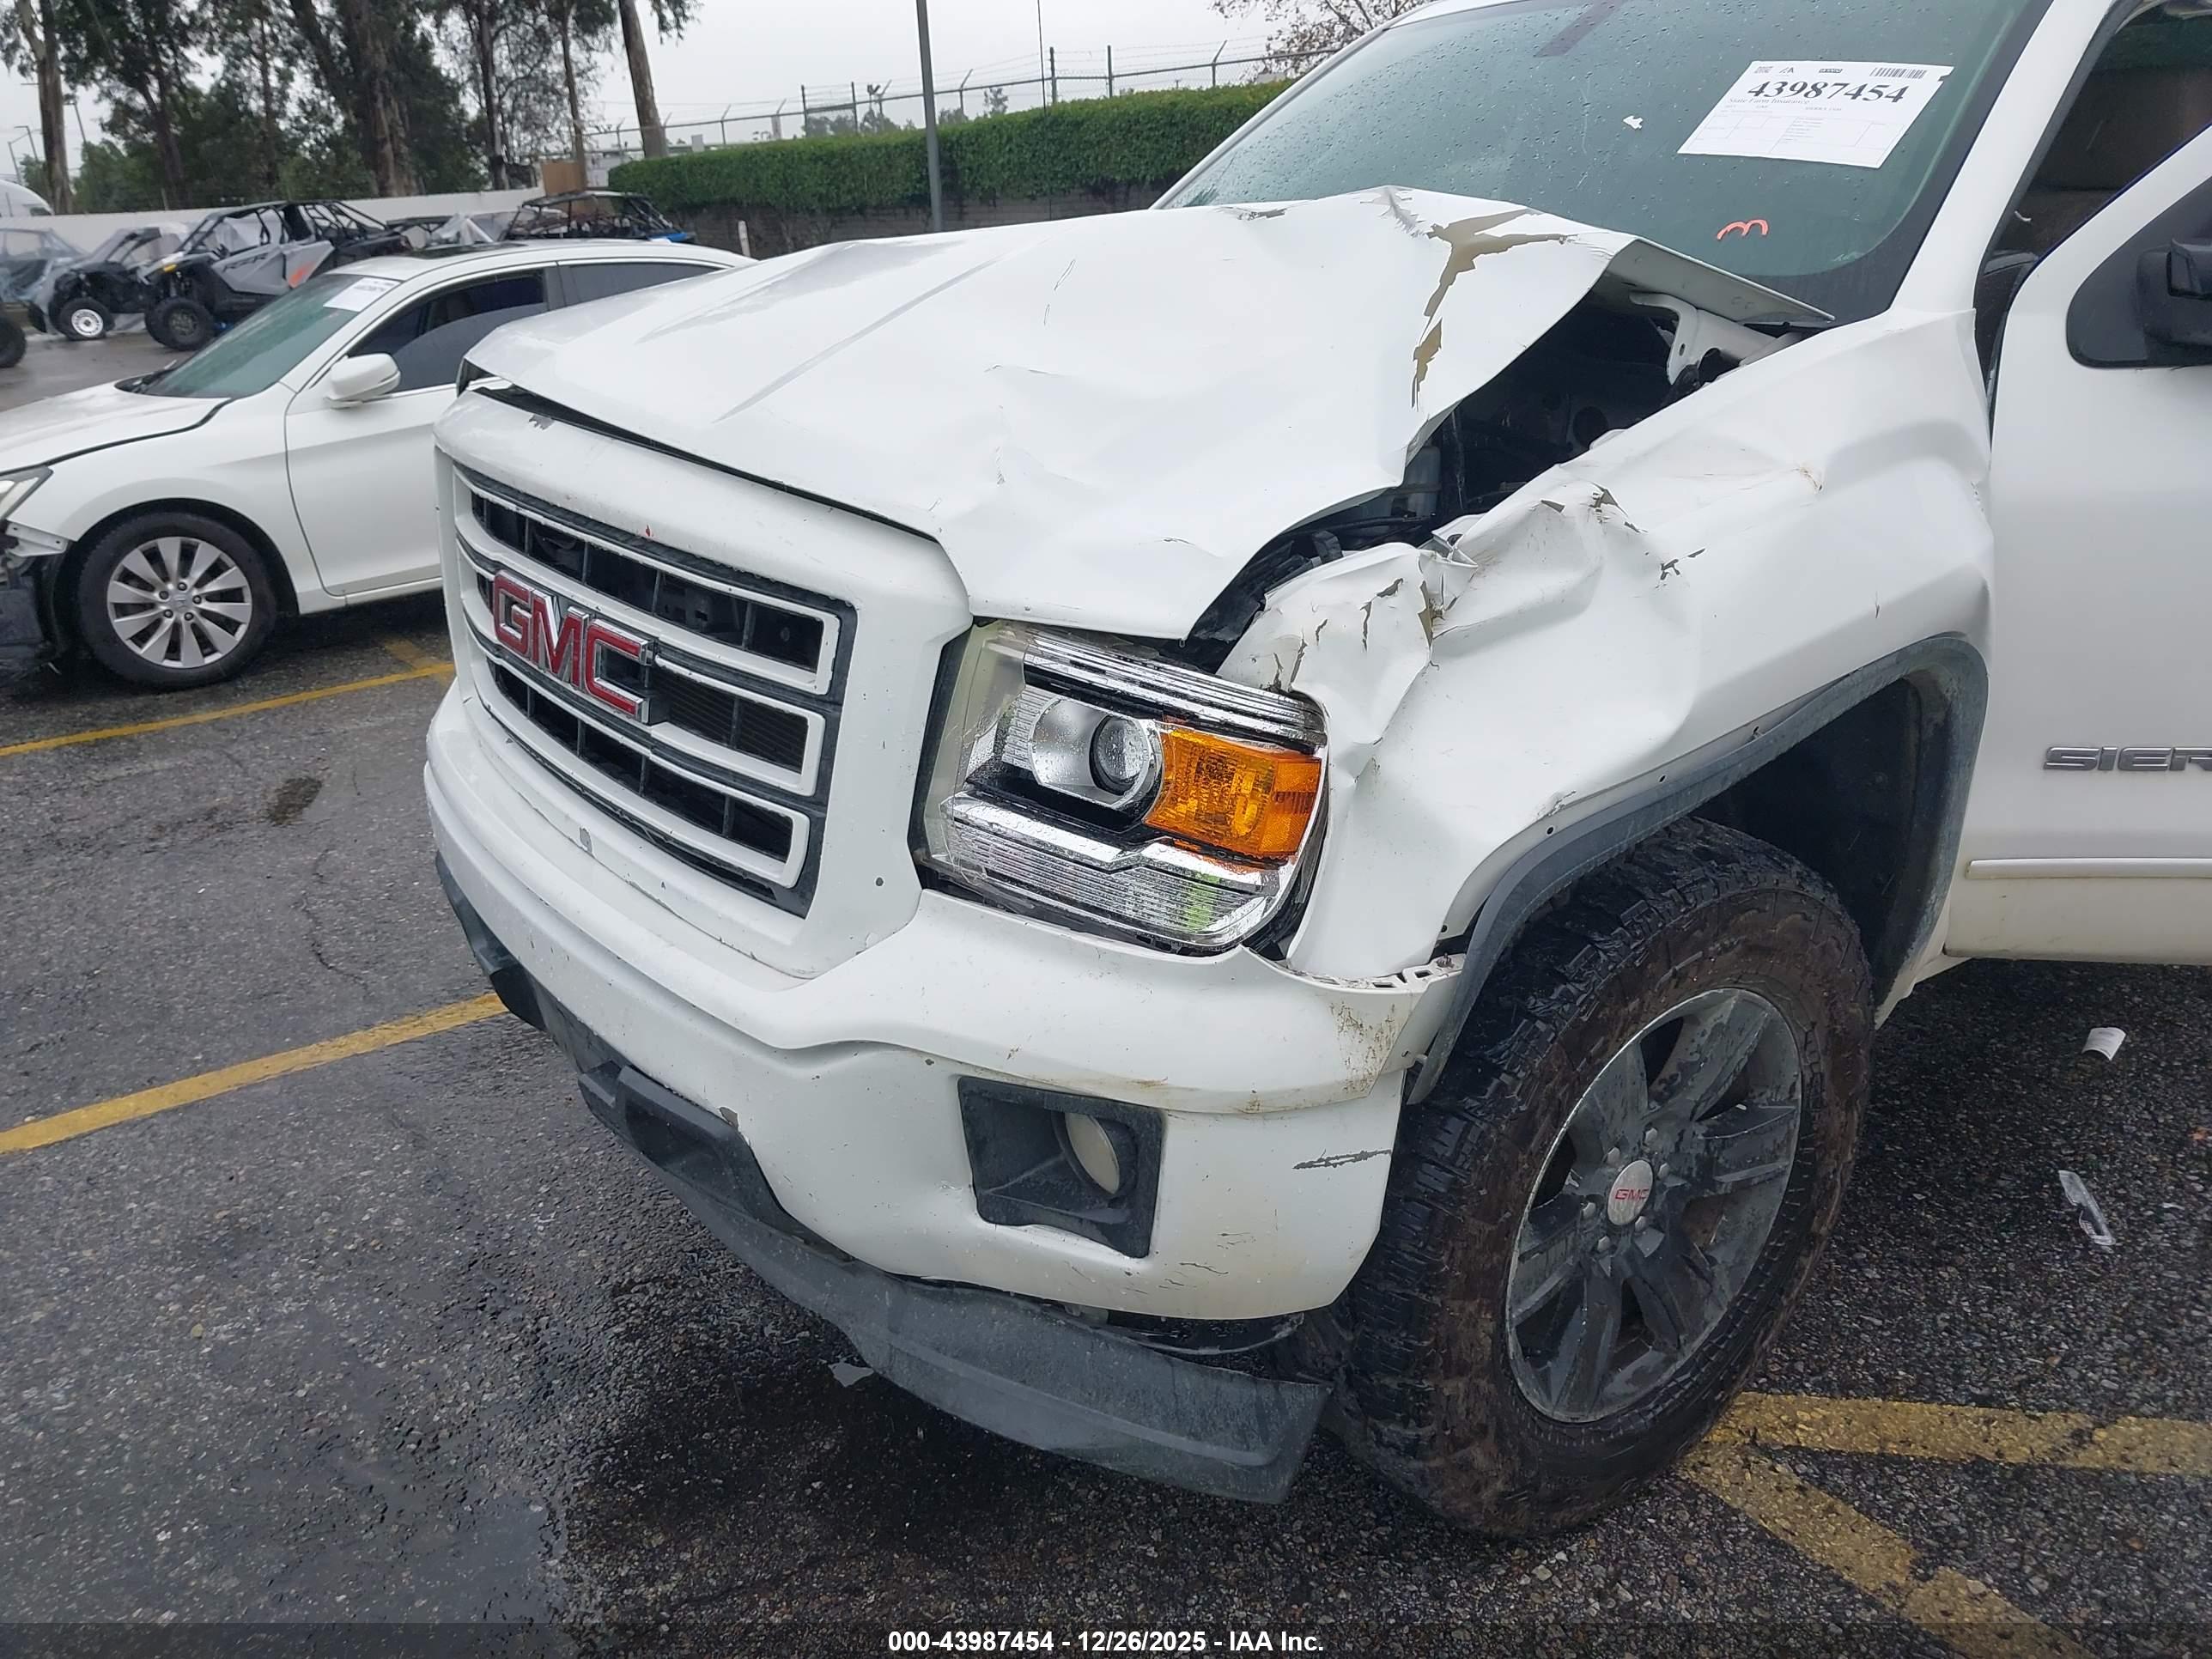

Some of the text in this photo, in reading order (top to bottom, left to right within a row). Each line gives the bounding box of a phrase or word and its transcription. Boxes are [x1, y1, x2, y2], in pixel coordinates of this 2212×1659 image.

[1747, 80, 1910, 103] 43987454
[493, 568, 652, 723] GMC
[1614, 1188, 1649, 1200] GMC
